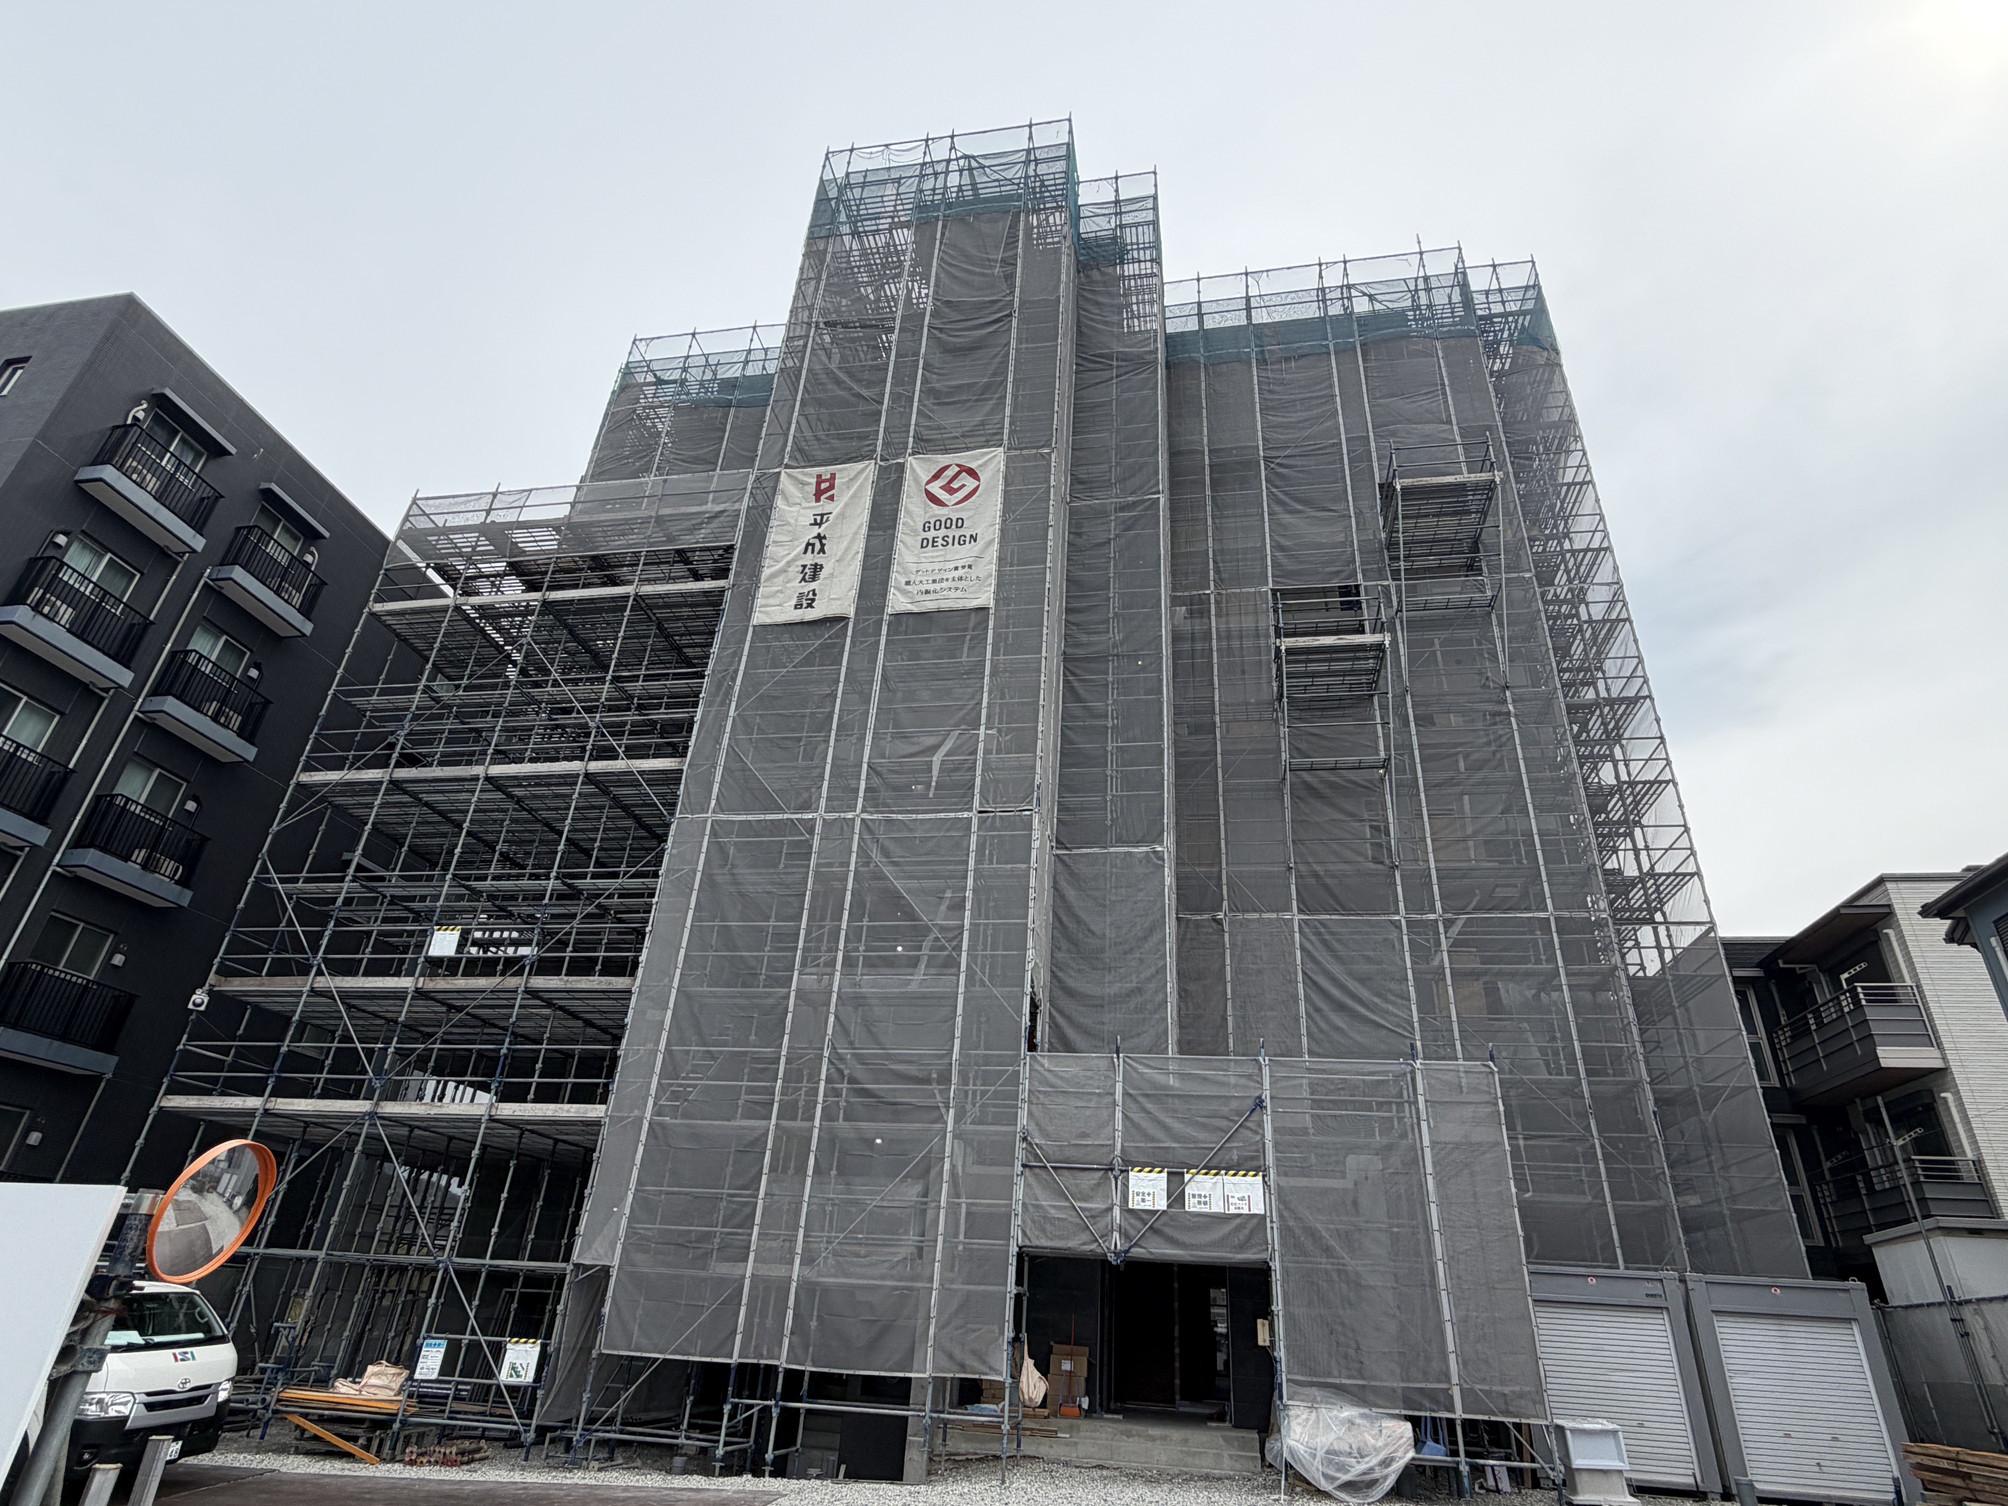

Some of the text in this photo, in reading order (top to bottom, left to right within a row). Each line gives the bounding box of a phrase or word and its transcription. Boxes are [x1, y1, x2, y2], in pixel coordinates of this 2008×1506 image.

[922, 517, 965, 533] GOOD
[920, 532, 978, 549] DESIGN
[794, 511, 834, 610] 平成建設
